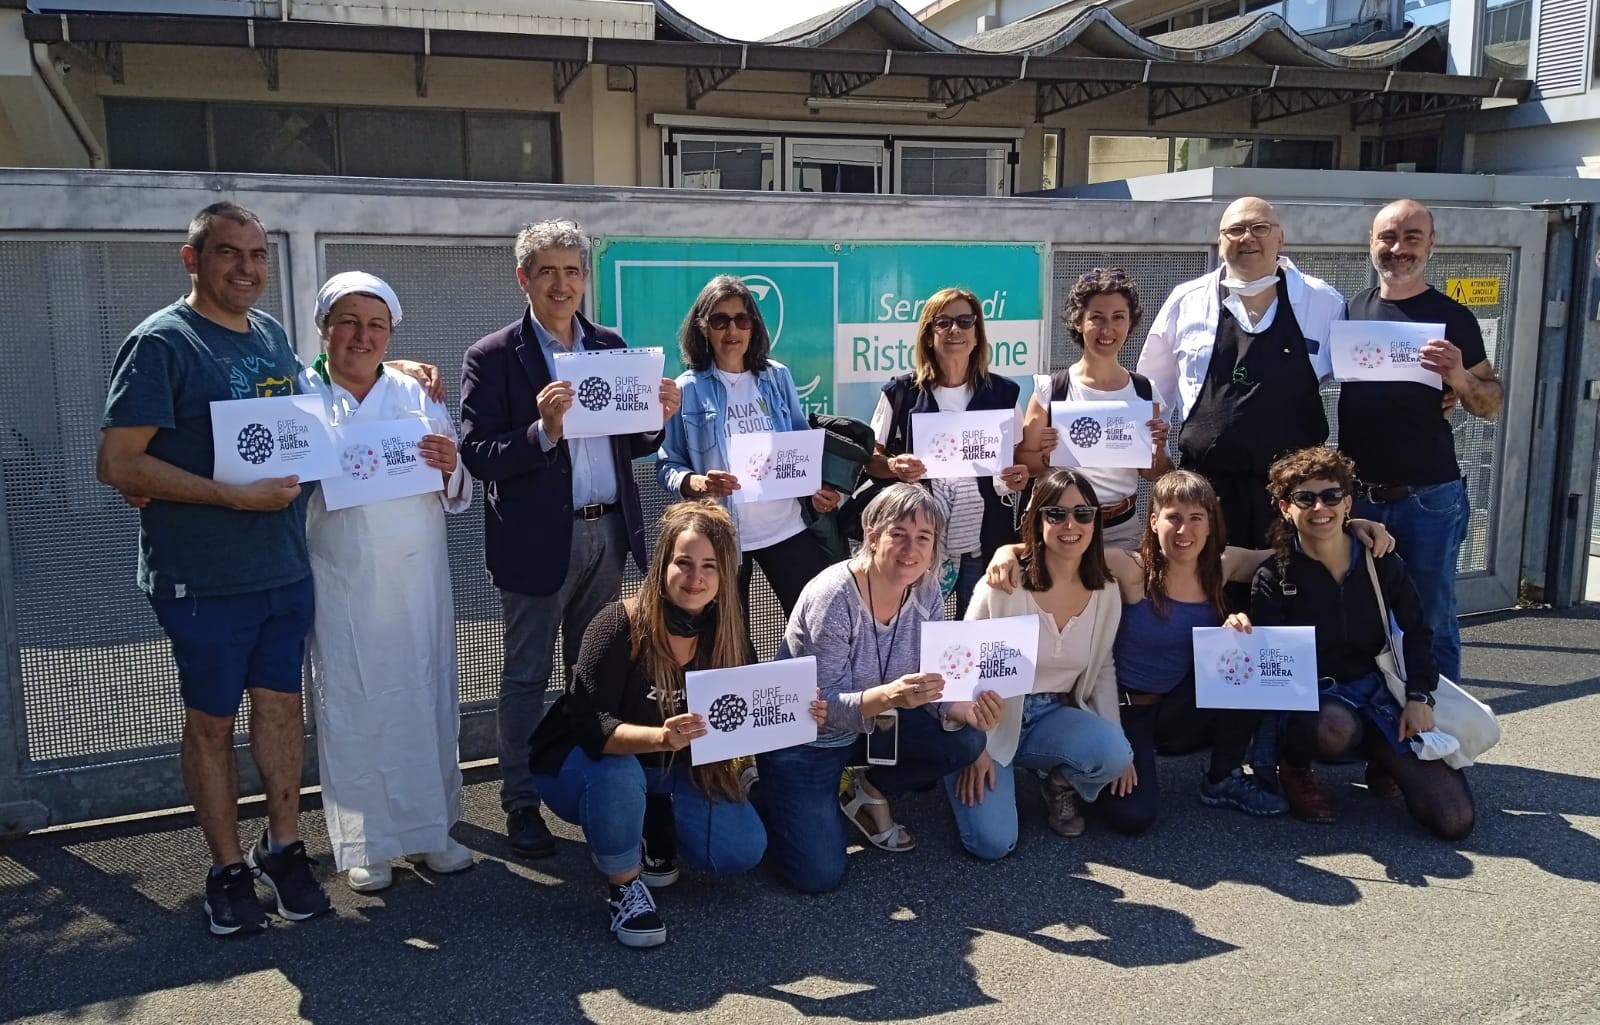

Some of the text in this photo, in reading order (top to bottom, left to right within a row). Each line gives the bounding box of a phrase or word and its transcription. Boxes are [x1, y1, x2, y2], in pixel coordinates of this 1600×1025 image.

[982, 291, 1007, 319] di
[615, 376, 639, 386] GURE
[615, 384, 652, 394] PLATERA
[614, 394, 639, 402] GURE
[615, 402, 649, 411] AUKERA
[277, 418, 296, 428] GURE
[278, 425, 309, 434] PLATERA
[962, 430, 985, 439] GURE
[278, 434, 298, 443] GURE
[381, 436, 401, 446] GURE
[962, 436, 999, 446] PLATERA
[280, 440, 310, 450] AUKERA
[384, 440, 417, 452] PLATERA
[962, 444, 985, 454] GURE
[384, 449, 405, 460] GURE
[777, 448, 798, 459] GURE
[962, 451, 997, 461] AUKERA
[386, 454, 417, 466] AUKERA
[777, 455, 810, 465] PLATERA
[776, 464, 797, 472] GURE
[776, 470, 807, 480] AUKERA
[980, 640, 1006, 652] GURE
[980, 648, 1022, 661] PLATERA
[1260, 648, 1280, 656] GURE
[979, 659, 1006, 670] GURE
[1260, 655, 1295, 664] PLATERA
[1260, 662, 1282, 670] GURE
[979, 667, 1018, 680] AUKERA
[752, 686, 781, 700] GURE
[752, 693, 800, 708] PLATERA
[752, 705, 782, 718] GURE
[752, 712, 796, 728] AUKERA
